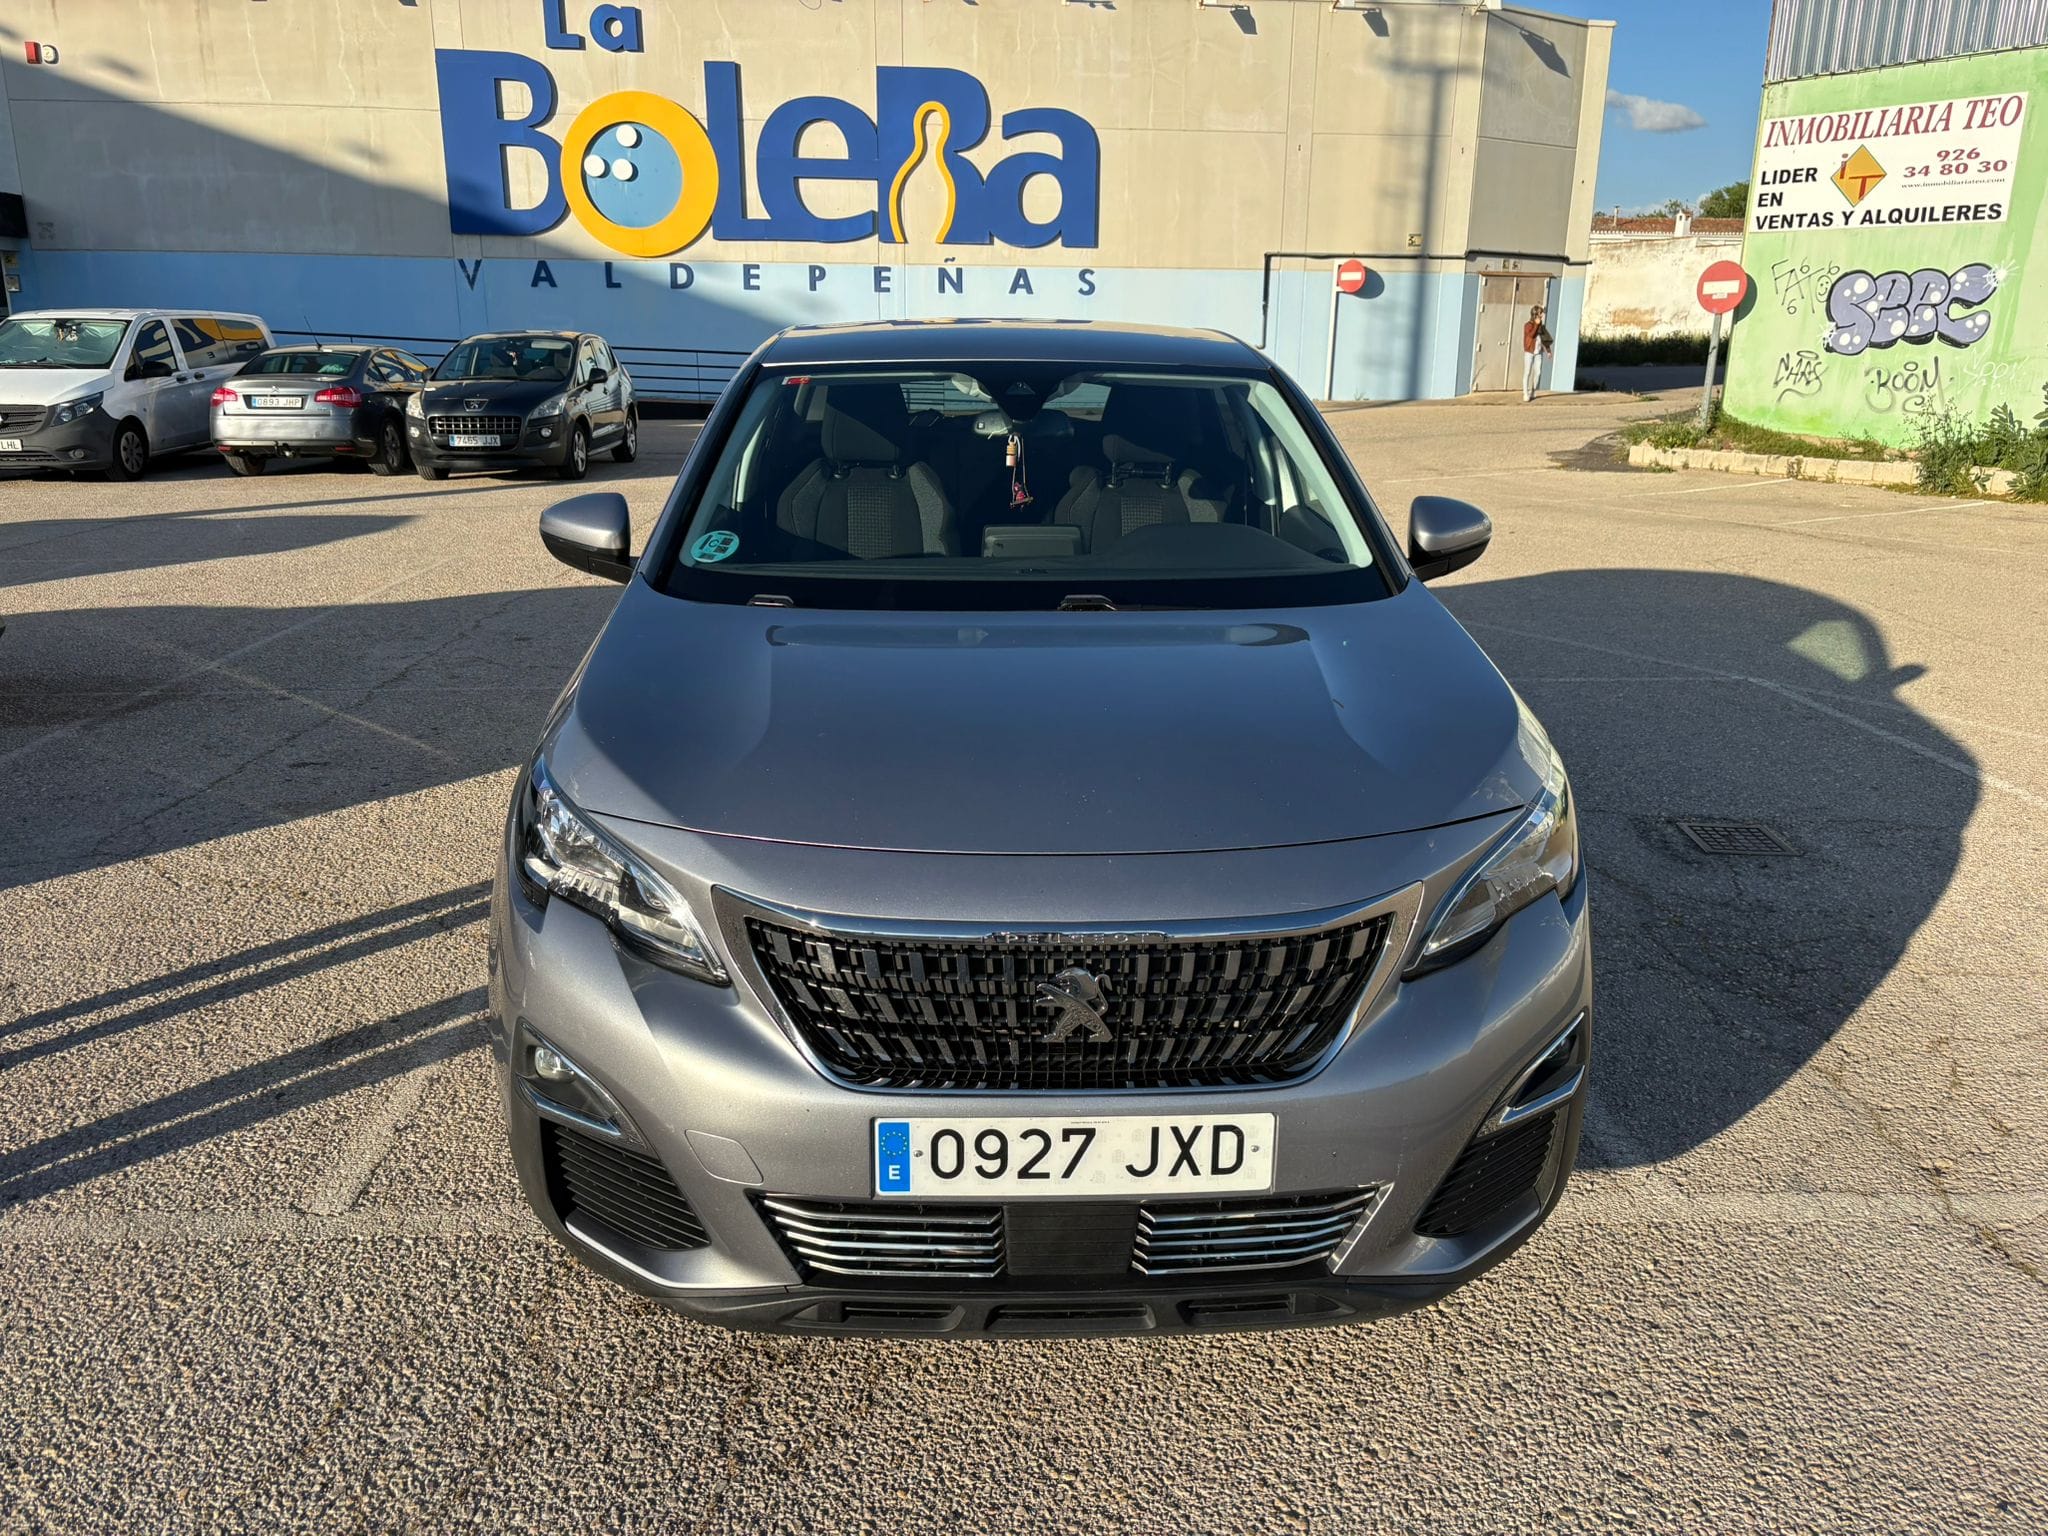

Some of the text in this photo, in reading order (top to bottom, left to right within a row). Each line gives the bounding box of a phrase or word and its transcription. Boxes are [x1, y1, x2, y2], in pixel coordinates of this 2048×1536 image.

[543, 0, 643, 53] La
[1764, 95, 2023, 148] INMOBILIARIA TEO
[1936, 147, 1981, 162] 926
[1760, 167, 1818, 186] LIDER
[1903, 159, 2008, 178] 34 80 30
[1757, 192, 1783, 208] EN
[1755, 203, 2003, 230] VENTAS Y ALQUILERES
[458, 257, 1097, 296] VALDEPEÑAS
[930, 1124, 1245, 1180] 0927 JXD
[888, 1165, 900, 1180] E
